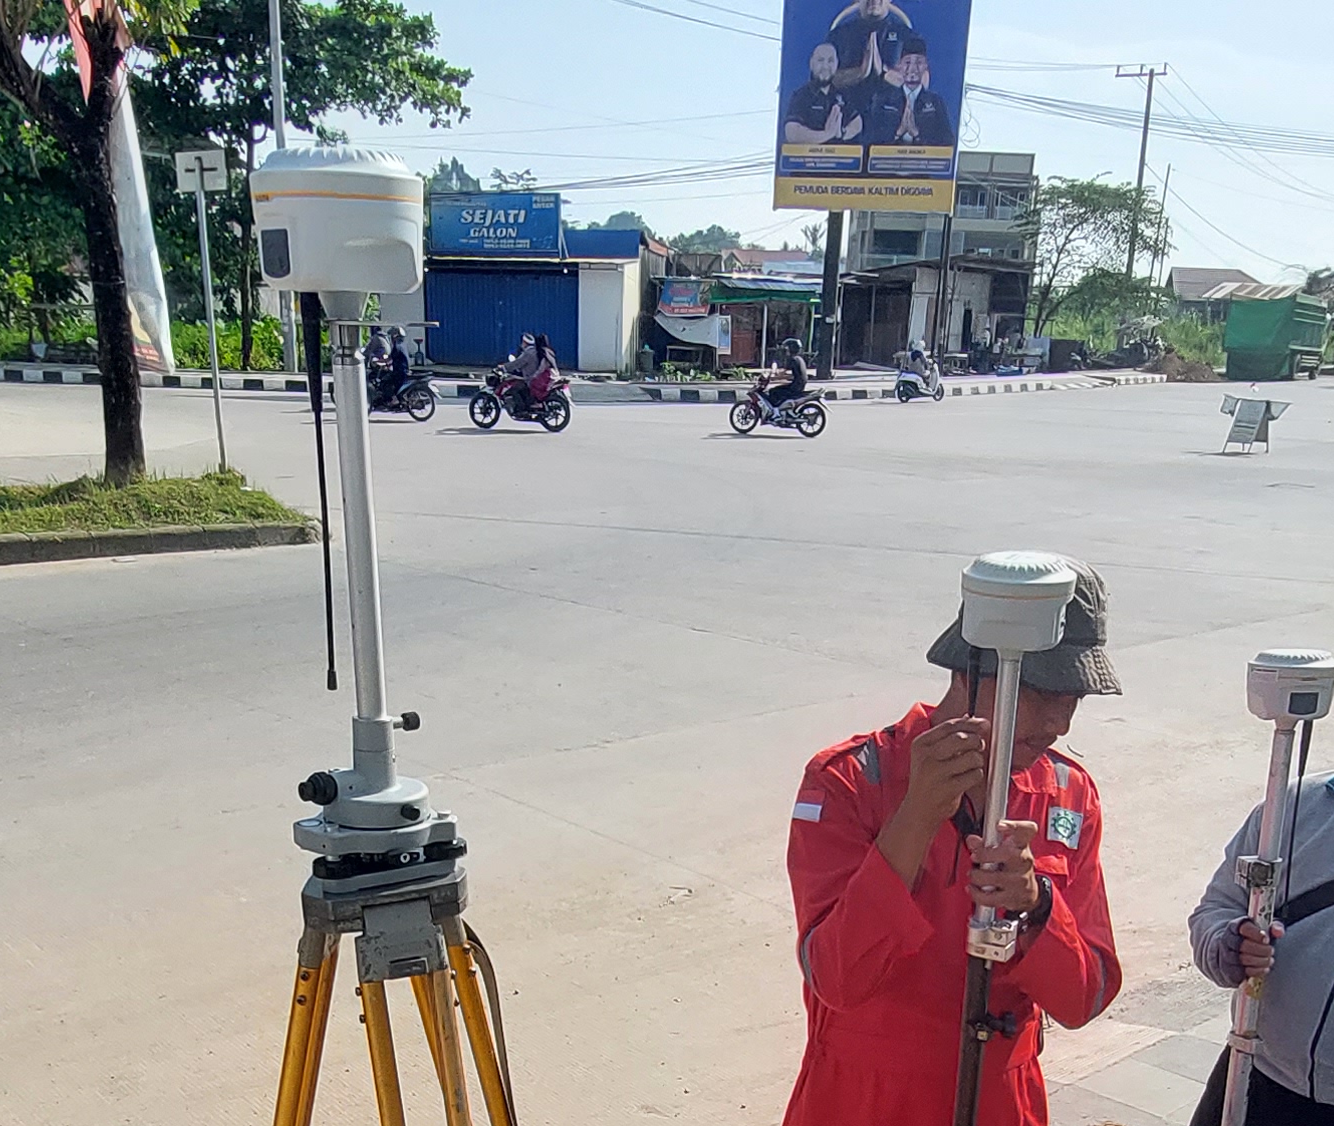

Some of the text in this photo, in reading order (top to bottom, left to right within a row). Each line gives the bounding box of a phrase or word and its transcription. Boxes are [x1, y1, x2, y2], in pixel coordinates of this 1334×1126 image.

[867, 186, 899, 196] KALTIM
[460, 209, 527, 227] SEJATI
[469, 227, 518, 238] GALON
